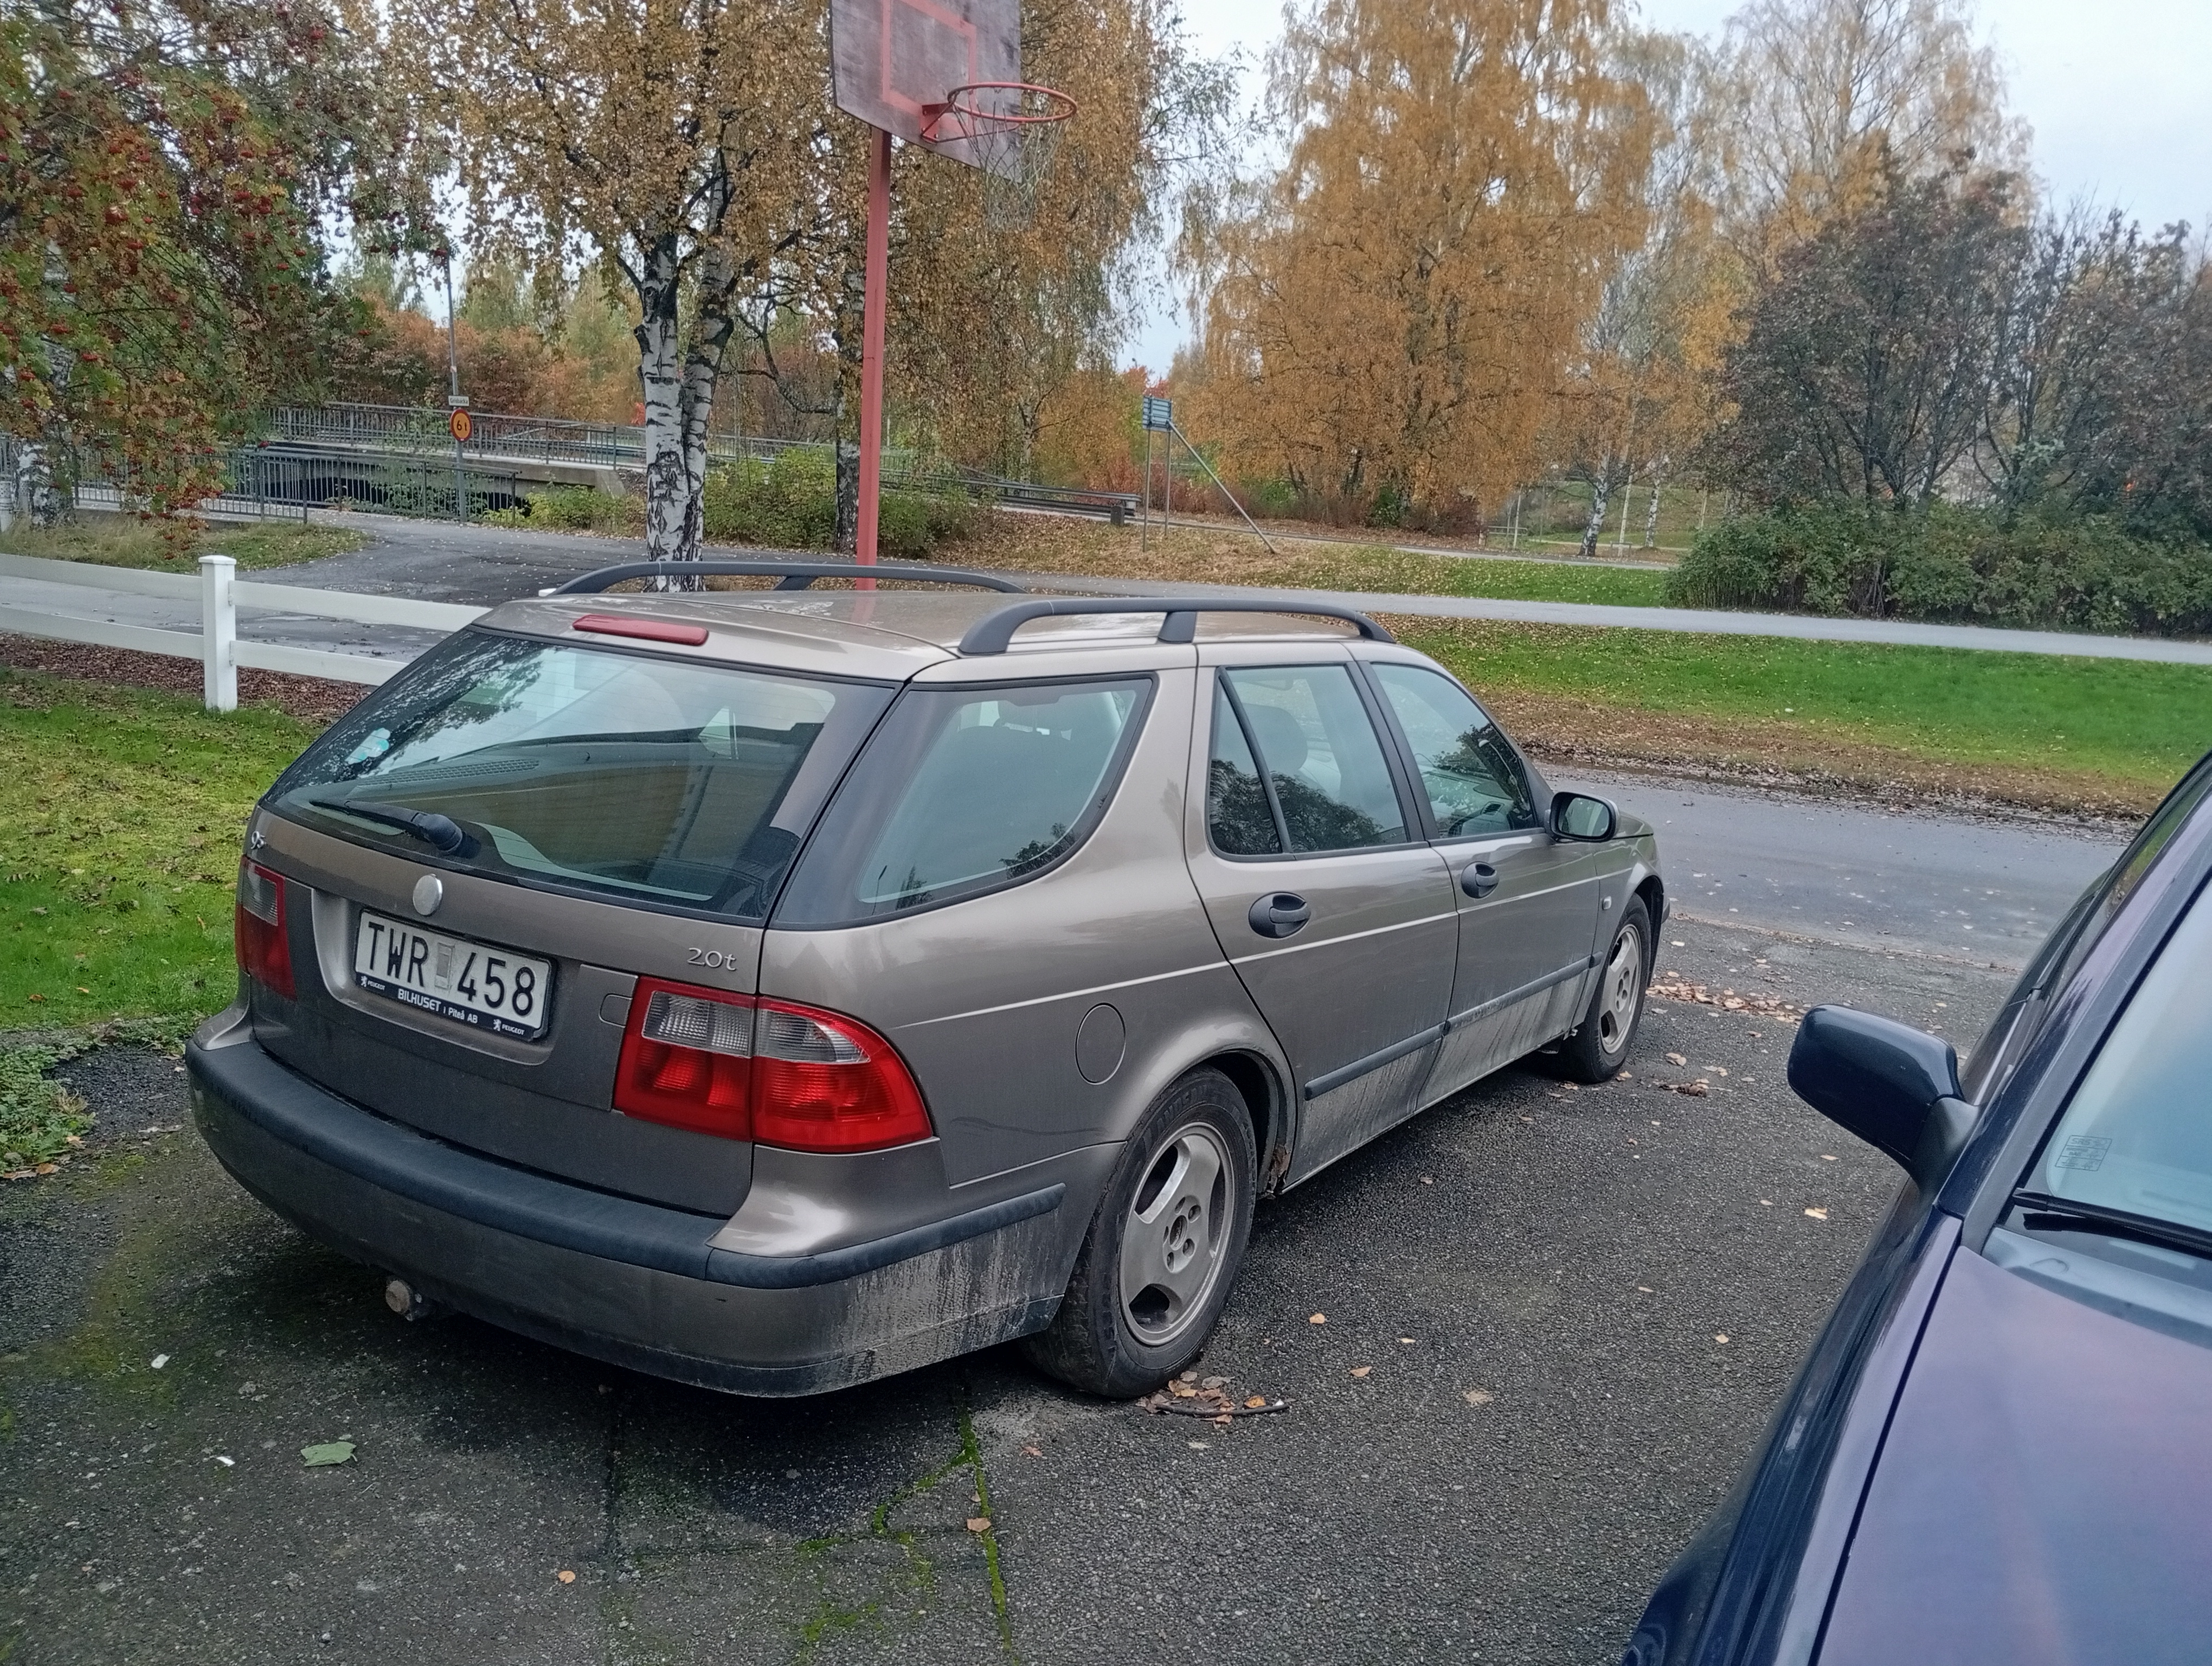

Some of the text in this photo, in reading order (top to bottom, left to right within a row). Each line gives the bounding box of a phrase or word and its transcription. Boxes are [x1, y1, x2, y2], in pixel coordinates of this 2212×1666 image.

[456, 420, 462, 431] 6
[368, 921, 535, 1016] TWR 458
[368, 980, 385, 990] PEUGEOT
[398, 988, 441, 1012] BILHUSET
[448, 1007, 465, 1020] Piteå
[467, 1013, 478, 1023] AB
[502, 1024, 525, 1035] PEUGEOT
